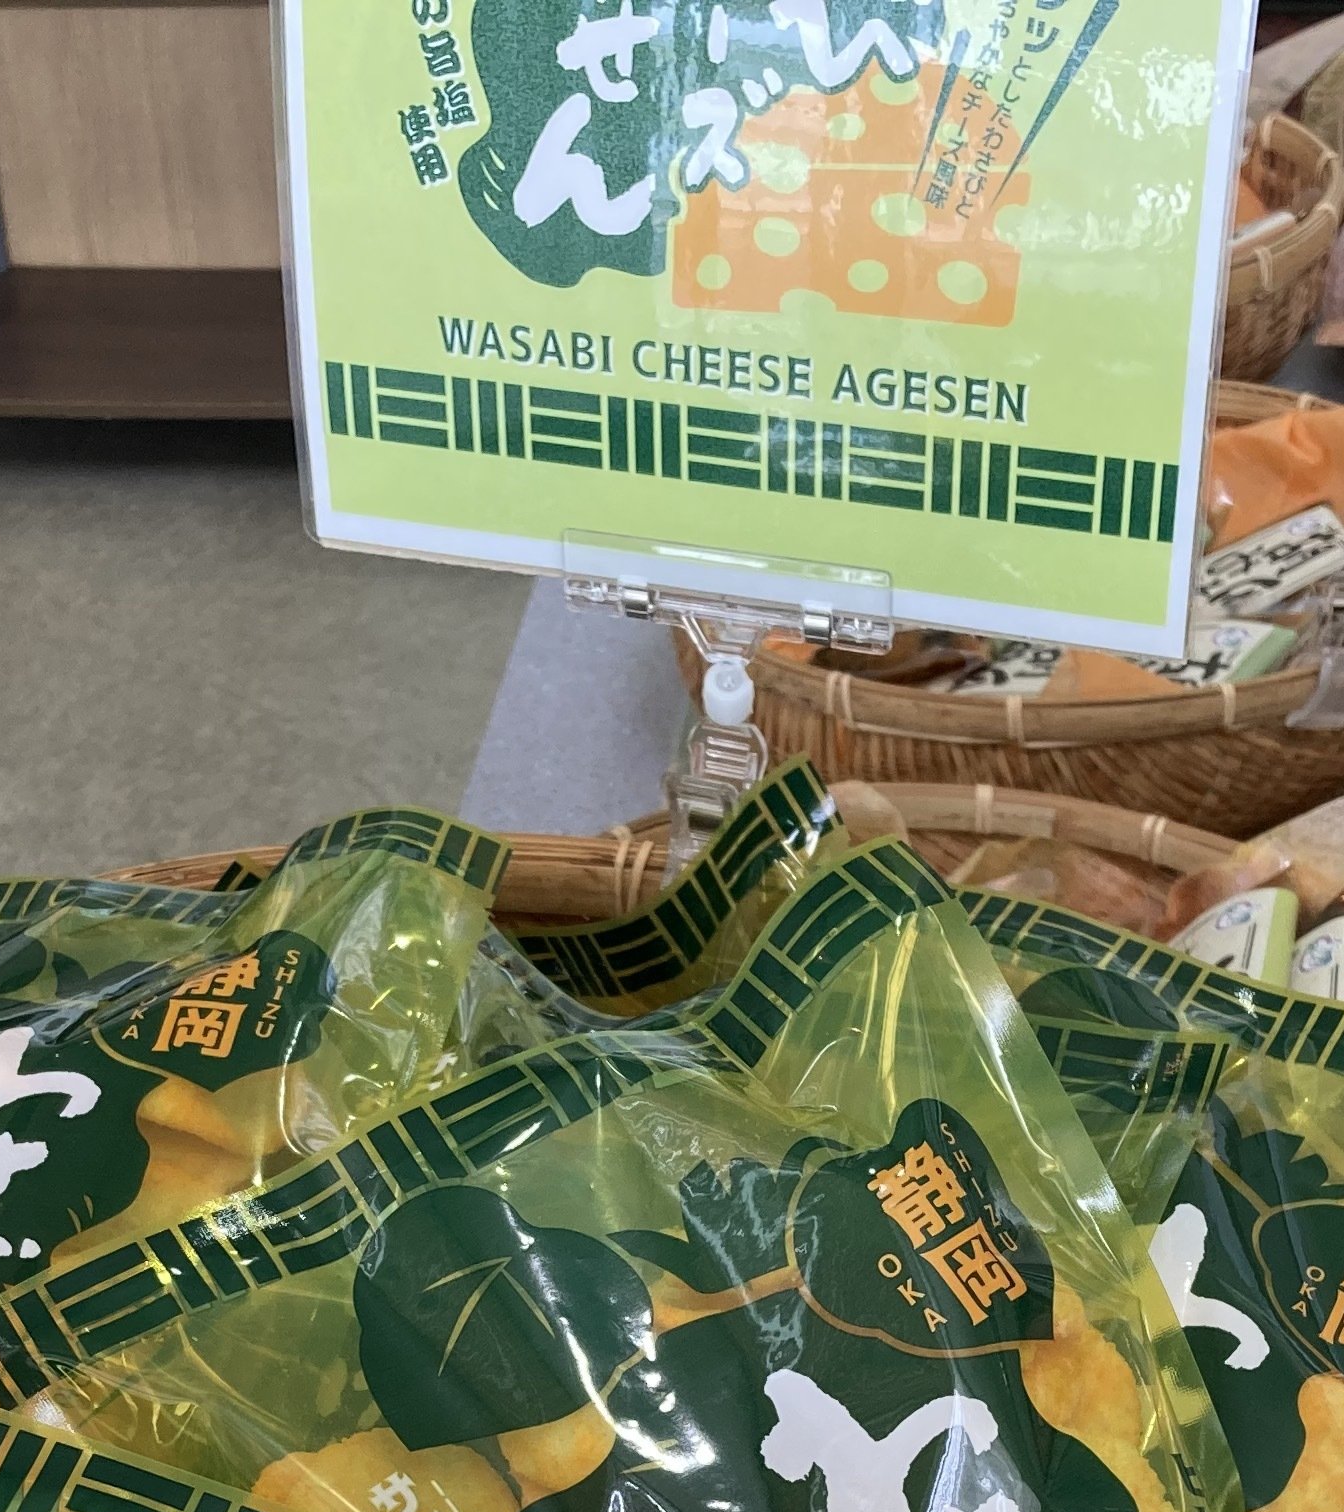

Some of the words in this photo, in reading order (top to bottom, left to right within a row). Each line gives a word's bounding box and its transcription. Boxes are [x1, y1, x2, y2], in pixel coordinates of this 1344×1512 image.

[437, 314, 614, 375] WASABI
[633, 339, 813, 398] CHEESE
[831, 364, 1029, 427] AGESEN
[256, 948, 302, 1040] SHIZU
[870, 1140, 1029, 1327] 静岡
[939, 1121, 1018, 1255] SHIZU
[877, 1252, 951, 1334] OKA
[1291, 1265, 1326, 1319] OKA
